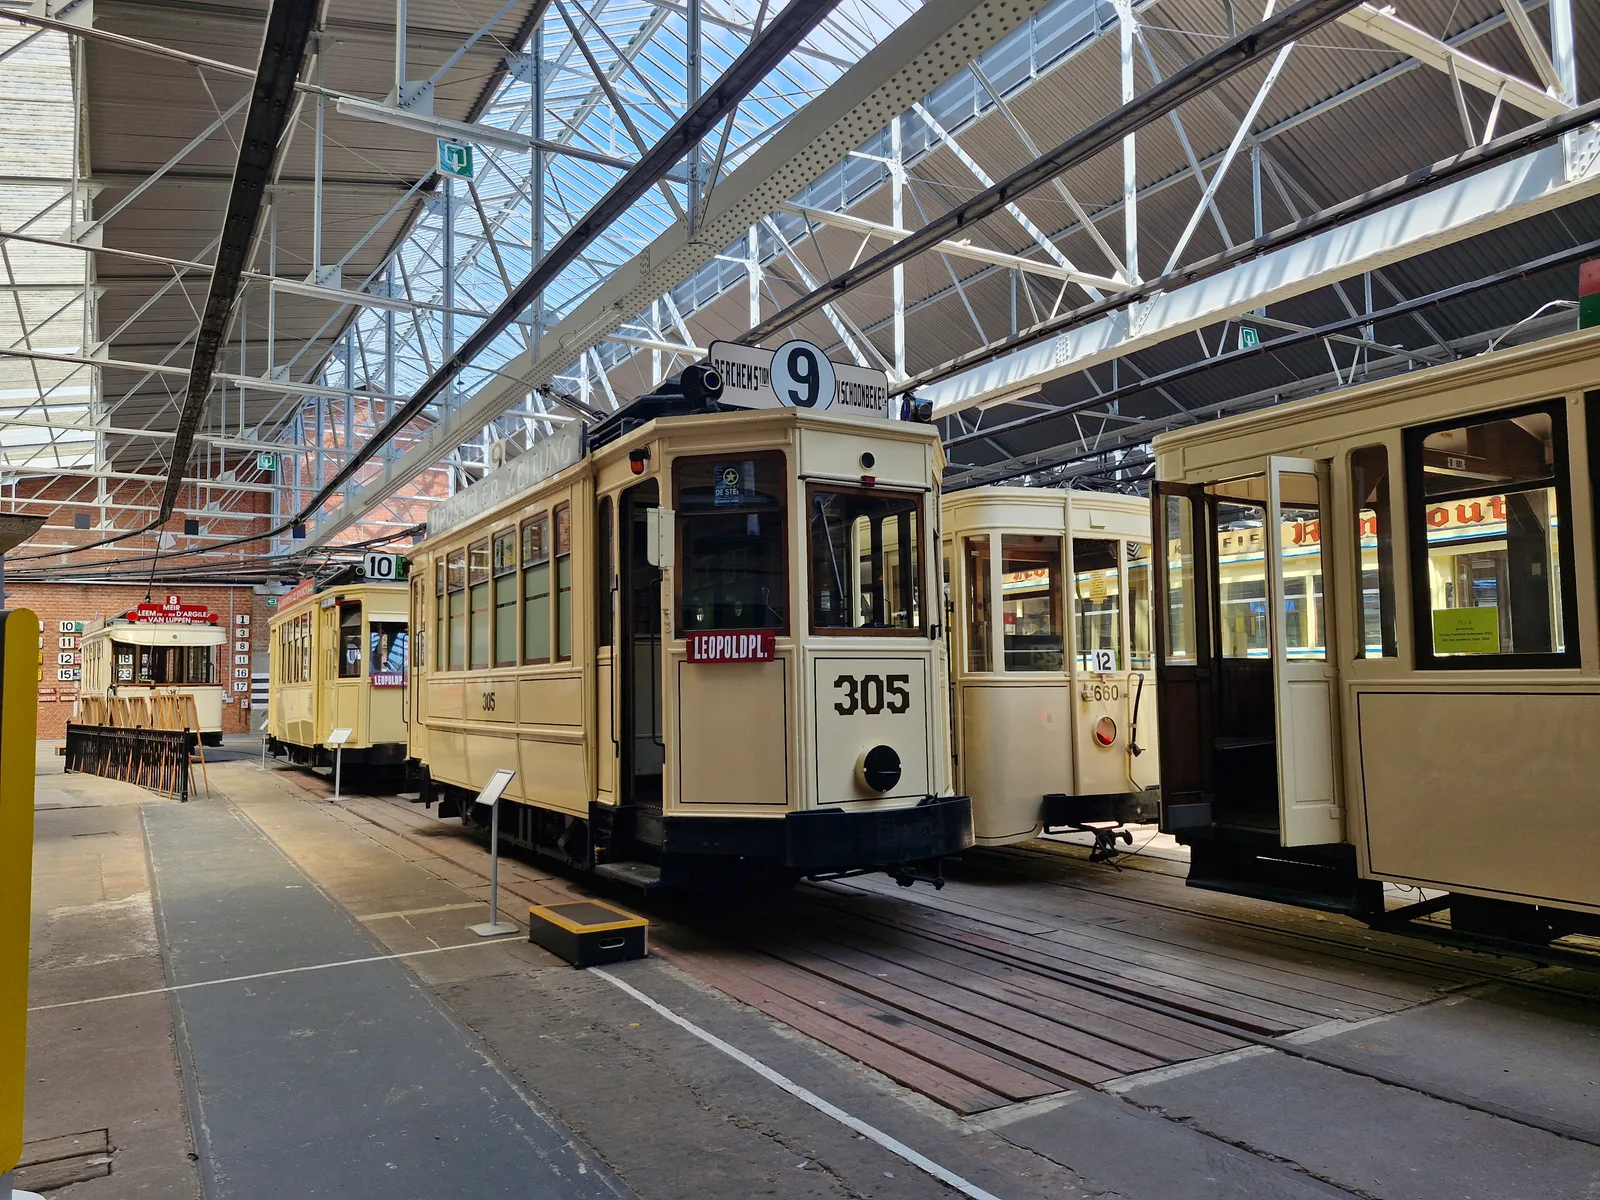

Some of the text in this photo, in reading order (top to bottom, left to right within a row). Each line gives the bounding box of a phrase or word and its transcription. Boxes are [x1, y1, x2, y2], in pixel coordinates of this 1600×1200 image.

[787, 347, 820, 408] 9
[504, 434, 572, 496] ZEITUNG
[369, 556, 392, 577] 10
[169, 595, 178, 605] 8
[62, 621, 74, 631] 10
[239, 629, 246, 637] 3
[61, 638, 72, 647] 11
[60, 654, 72, 664] 12
[1096, 651, 1112, 671] 12
[60, 670, 72, 679] 15
[118, 670, 131, 679] 23
[236, 683, 246, 691] 17
[833, 674, 911, 716] 305
[482, 691, 496, 712] 305
